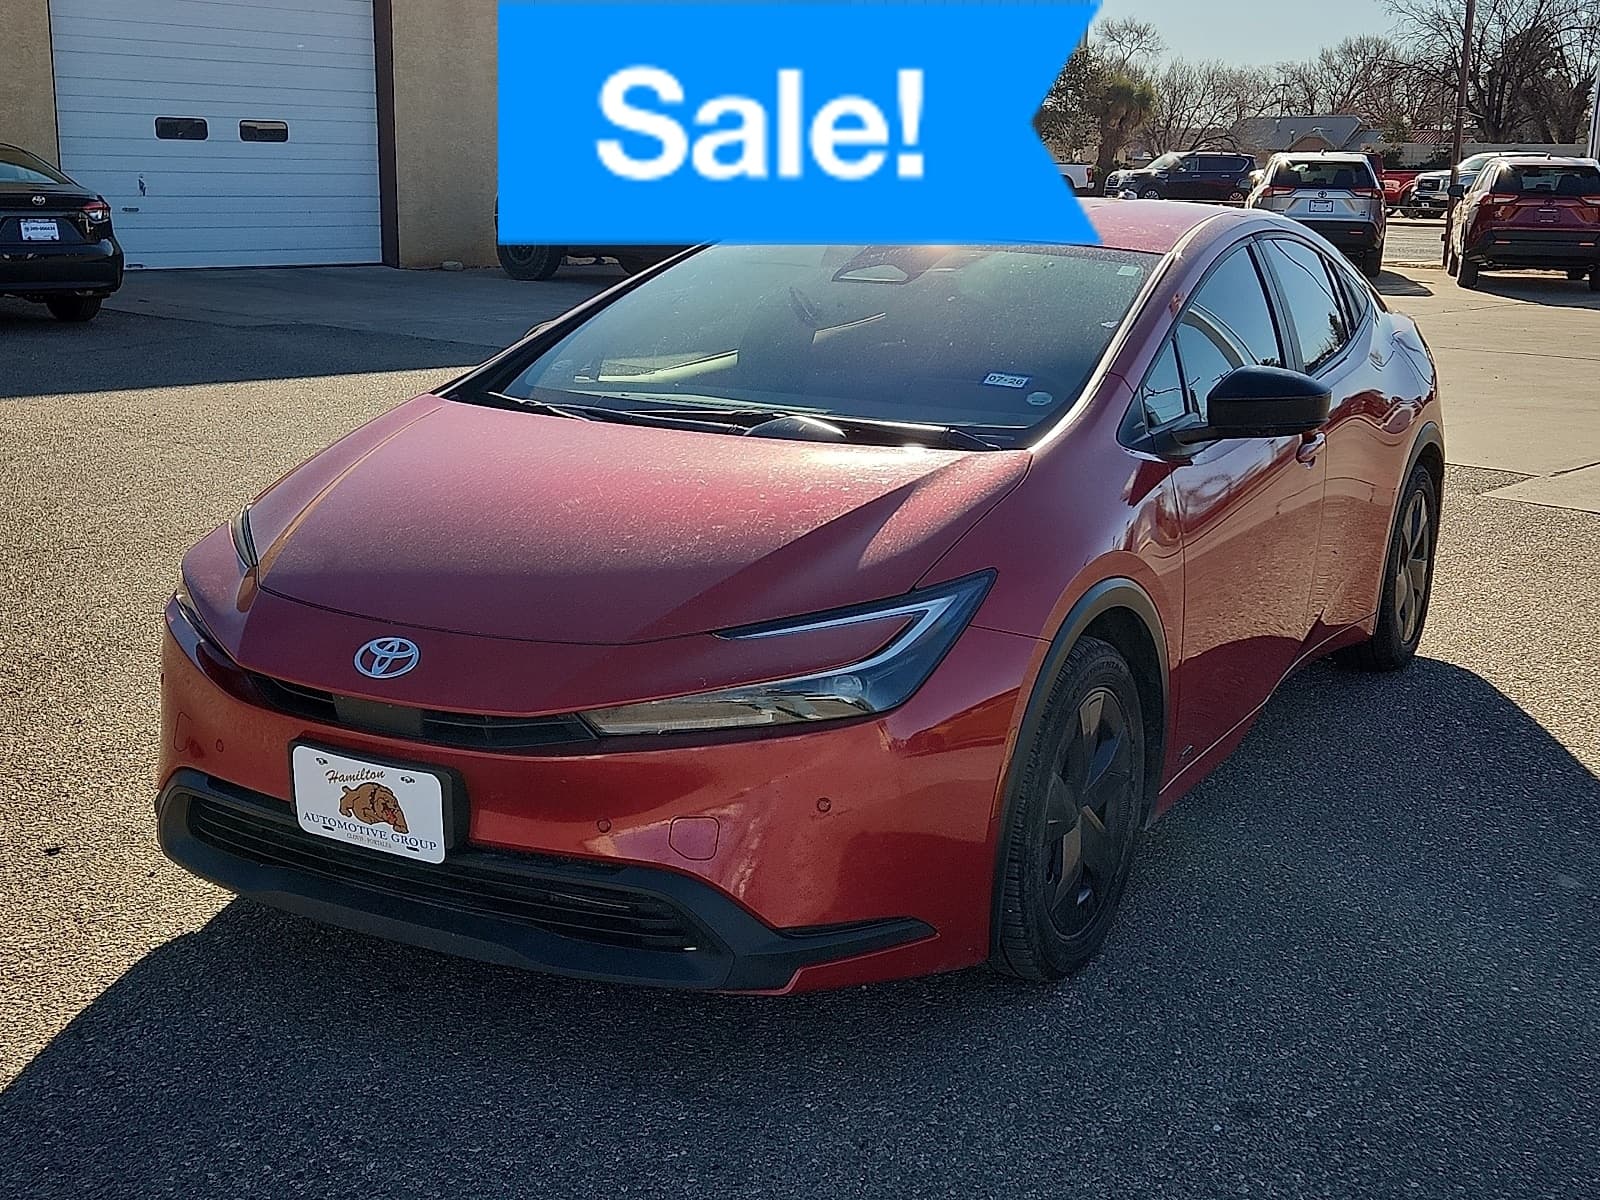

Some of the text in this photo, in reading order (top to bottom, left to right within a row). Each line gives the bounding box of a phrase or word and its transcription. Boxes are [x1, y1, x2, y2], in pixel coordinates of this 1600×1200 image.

[325, 767, 386, 784] Hamilton
[303, 812, 389, 840] AUTOMOTIVE
[391, 834, 437, 850] GROUP
